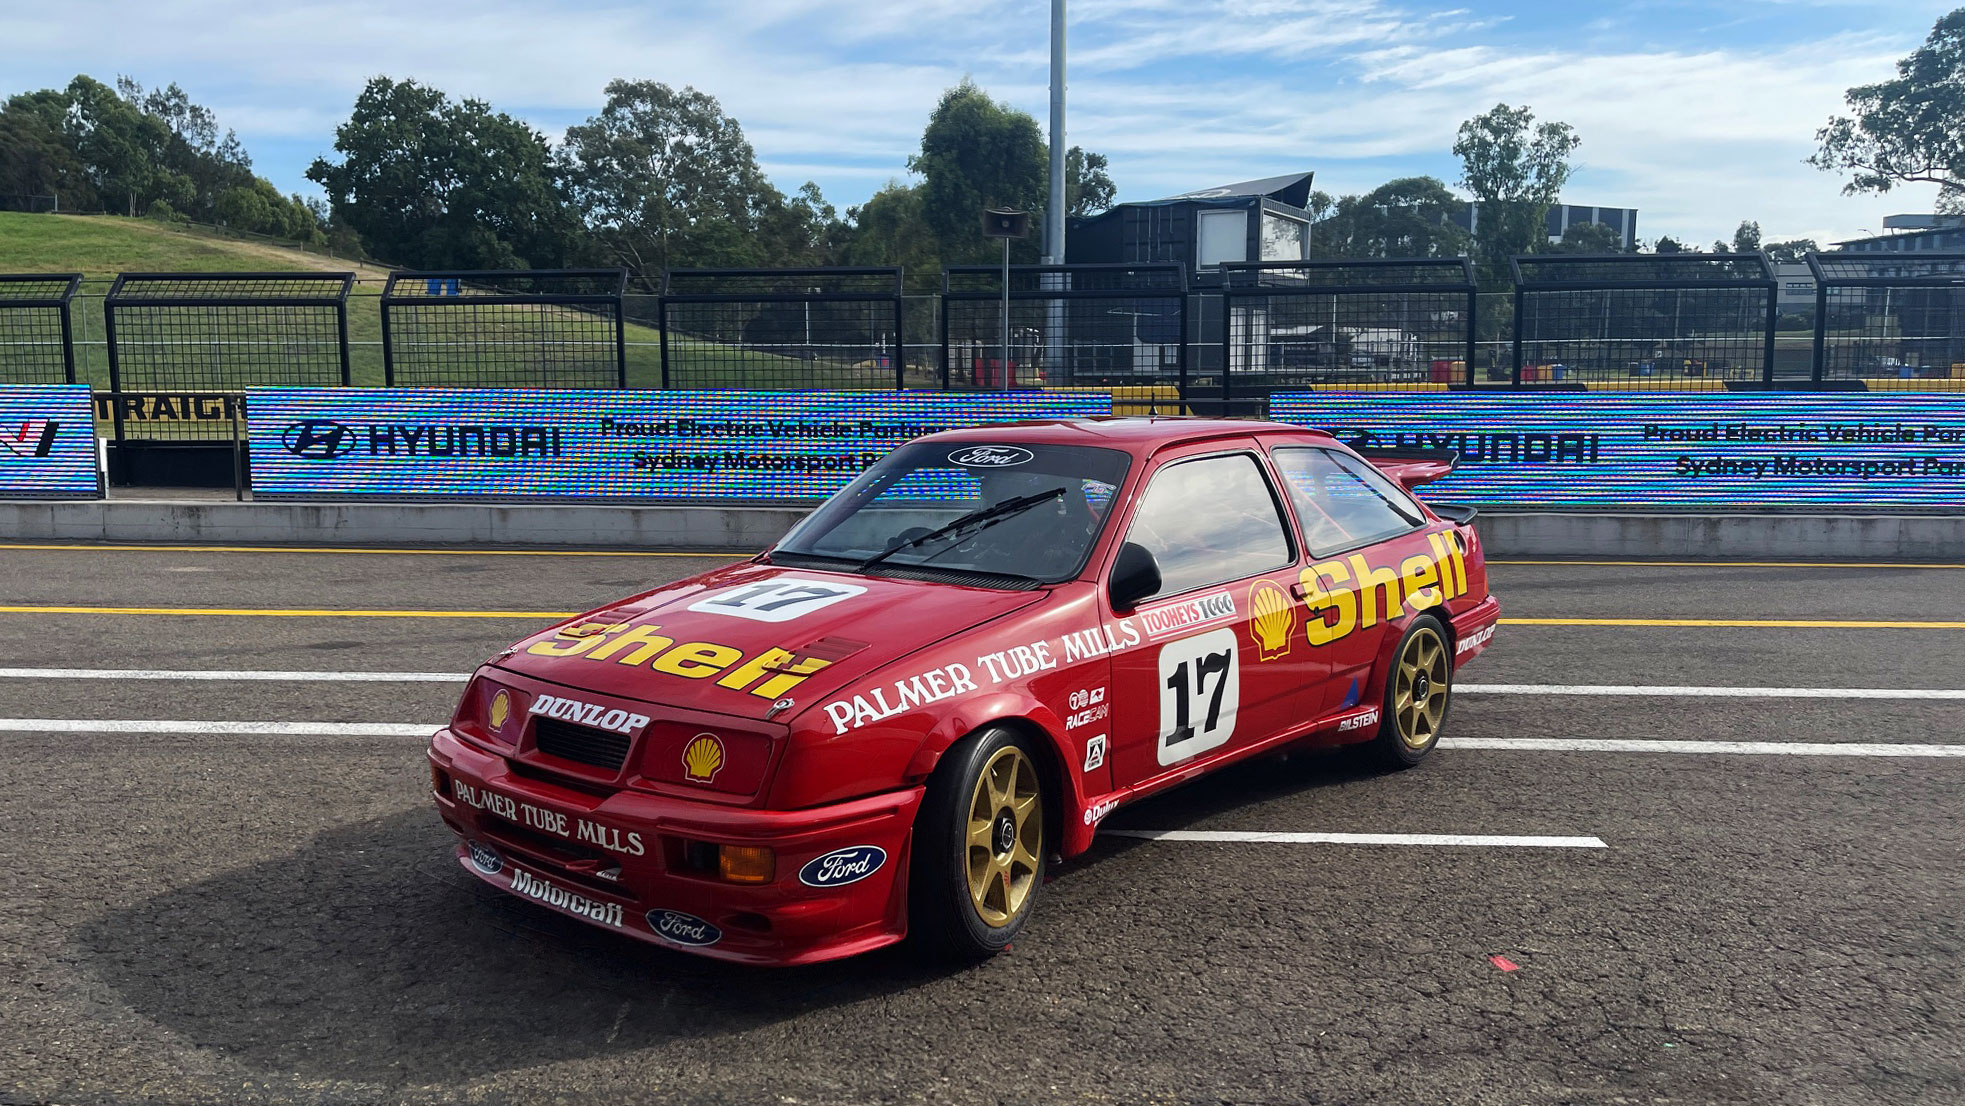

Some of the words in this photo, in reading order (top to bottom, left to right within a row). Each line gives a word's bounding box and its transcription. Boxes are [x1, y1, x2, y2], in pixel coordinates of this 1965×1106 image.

[369, 425, 560, 457] HYUNDAI
[601, 419, 669, 437] Proud
[676, 419, 764, 437] Electric
[768, 420, 852, 438] Vehicle
[1645, 422, 1718, 441] Proud
[1726, 422, 1817, 441] Electric
[1825, 423, 1915, 443] Vehicle
[633, 450, 719, 473] Sydney
[724, 451, 856, 475] Motorsport
[959, 446, 1019, 465] Ford
[1676, 456, 1767, 479] Sydney
[1774, 456, 1916, 480] Motorsport
[705, 583, 849, 612] 17
[1298, 529, 1469, 647] Shell
[1142, 602, 1200, 633] TOOHEYS
[1455, 623, 1497, 656] DUNLOP
[526, 622, 832, 701] Shell
[823, 661, 978, 736] PALMER
[977, 639, 1058, 684] TUBE
[1060, 619, 1142, 664] MILLS
[1165, 647, 1232, 748] 17
[528, 694, 650, 734] DUNLOP
[1065, 703, 1109, 731] RACECAM
[1337, 711, 1379, 733] BILSTEIN
[454, 779, 518, 822] PALMER
[520, 803, 570, 838] TUBE
[576, 818, 645, 857] MILLS
[817, 851, 872, 883] Ford
[509, 868, 624, 928] Motorcraft
[659, 911, 706, 941] Ford
